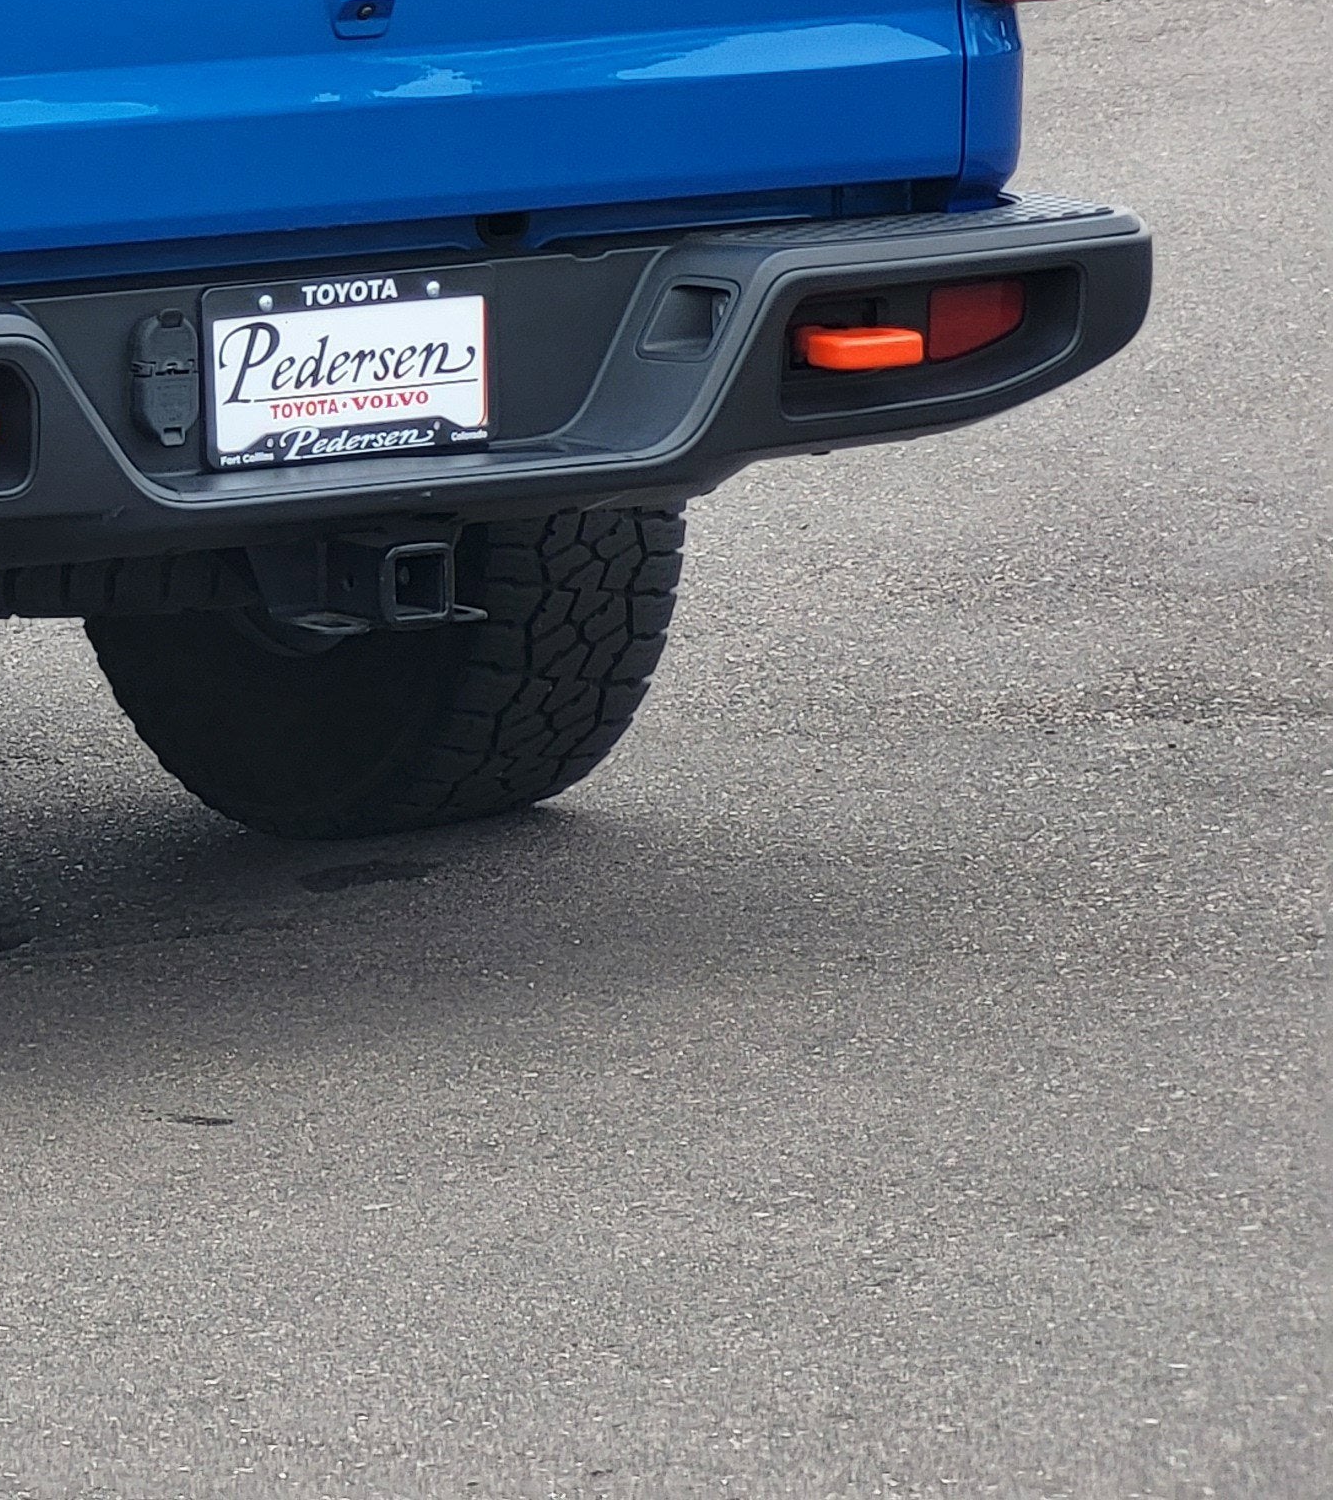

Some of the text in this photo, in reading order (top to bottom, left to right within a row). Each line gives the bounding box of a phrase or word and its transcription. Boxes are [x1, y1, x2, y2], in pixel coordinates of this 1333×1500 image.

[302, 278, 398, 306] TOYOTA
[219, 321, 476, 405] Pedersen
[270, 390, 429, 419] TOYOTA VOLVO
[279, 426, 435, 460] Pedersen
[451, 429, 488, 441] Colorado
[220, 451, 274, 466] Fort Collins
